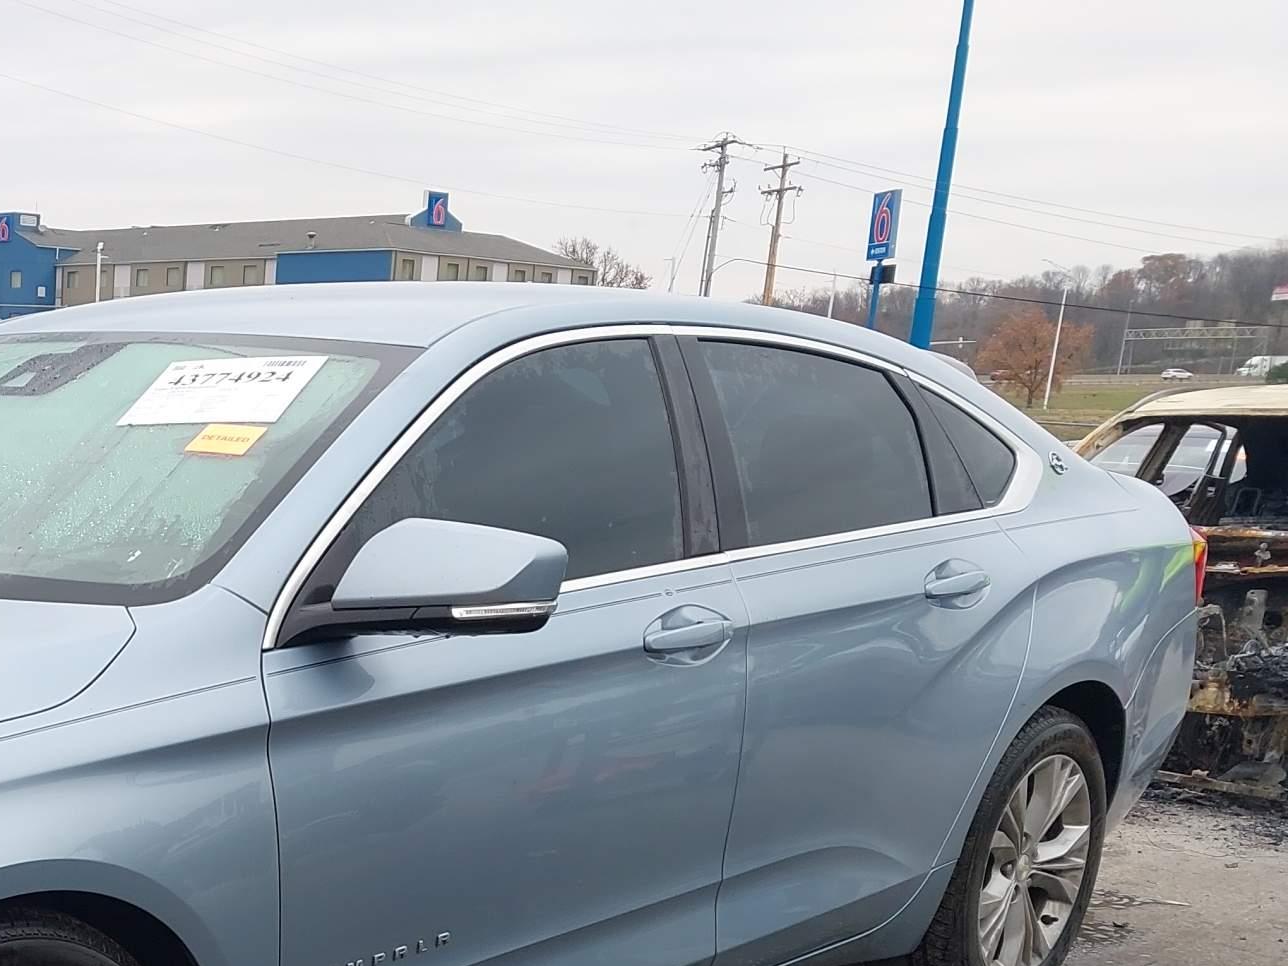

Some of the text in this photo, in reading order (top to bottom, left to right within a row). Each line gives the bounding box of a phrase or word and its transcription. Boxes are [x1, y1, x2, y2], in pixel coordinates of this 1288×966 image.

[433, 198, 446, 225] 6
[874, 192, 891, 243] 6
[168, 370, 294, 386] 43774924
[200, 433, 252, 444] DETAILED
